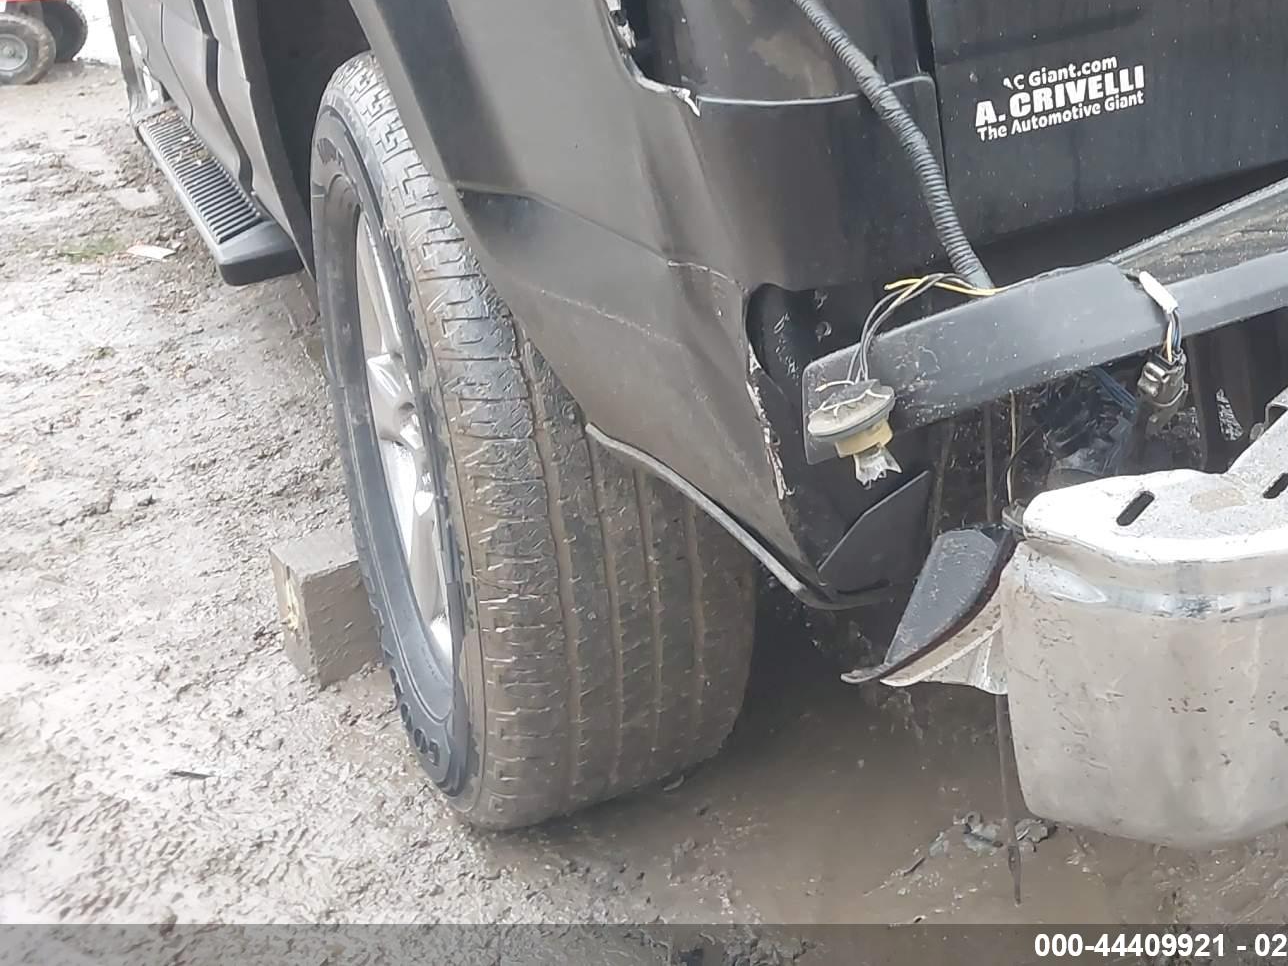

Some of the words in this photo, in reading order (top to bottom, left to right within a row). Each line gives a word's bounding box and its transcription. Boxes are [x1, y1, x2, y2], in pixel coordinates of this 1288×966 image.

[975, 100, 1006, 127] A.
[1009, 65, 1145, 118] CRIVELLI
[1028, 56, 1118, 87] Giant.com
[976, 125, 1007, 142] The
[1011, 102, 1101, 135] Automotive
[1104, 90, 1144, 112] Giant
